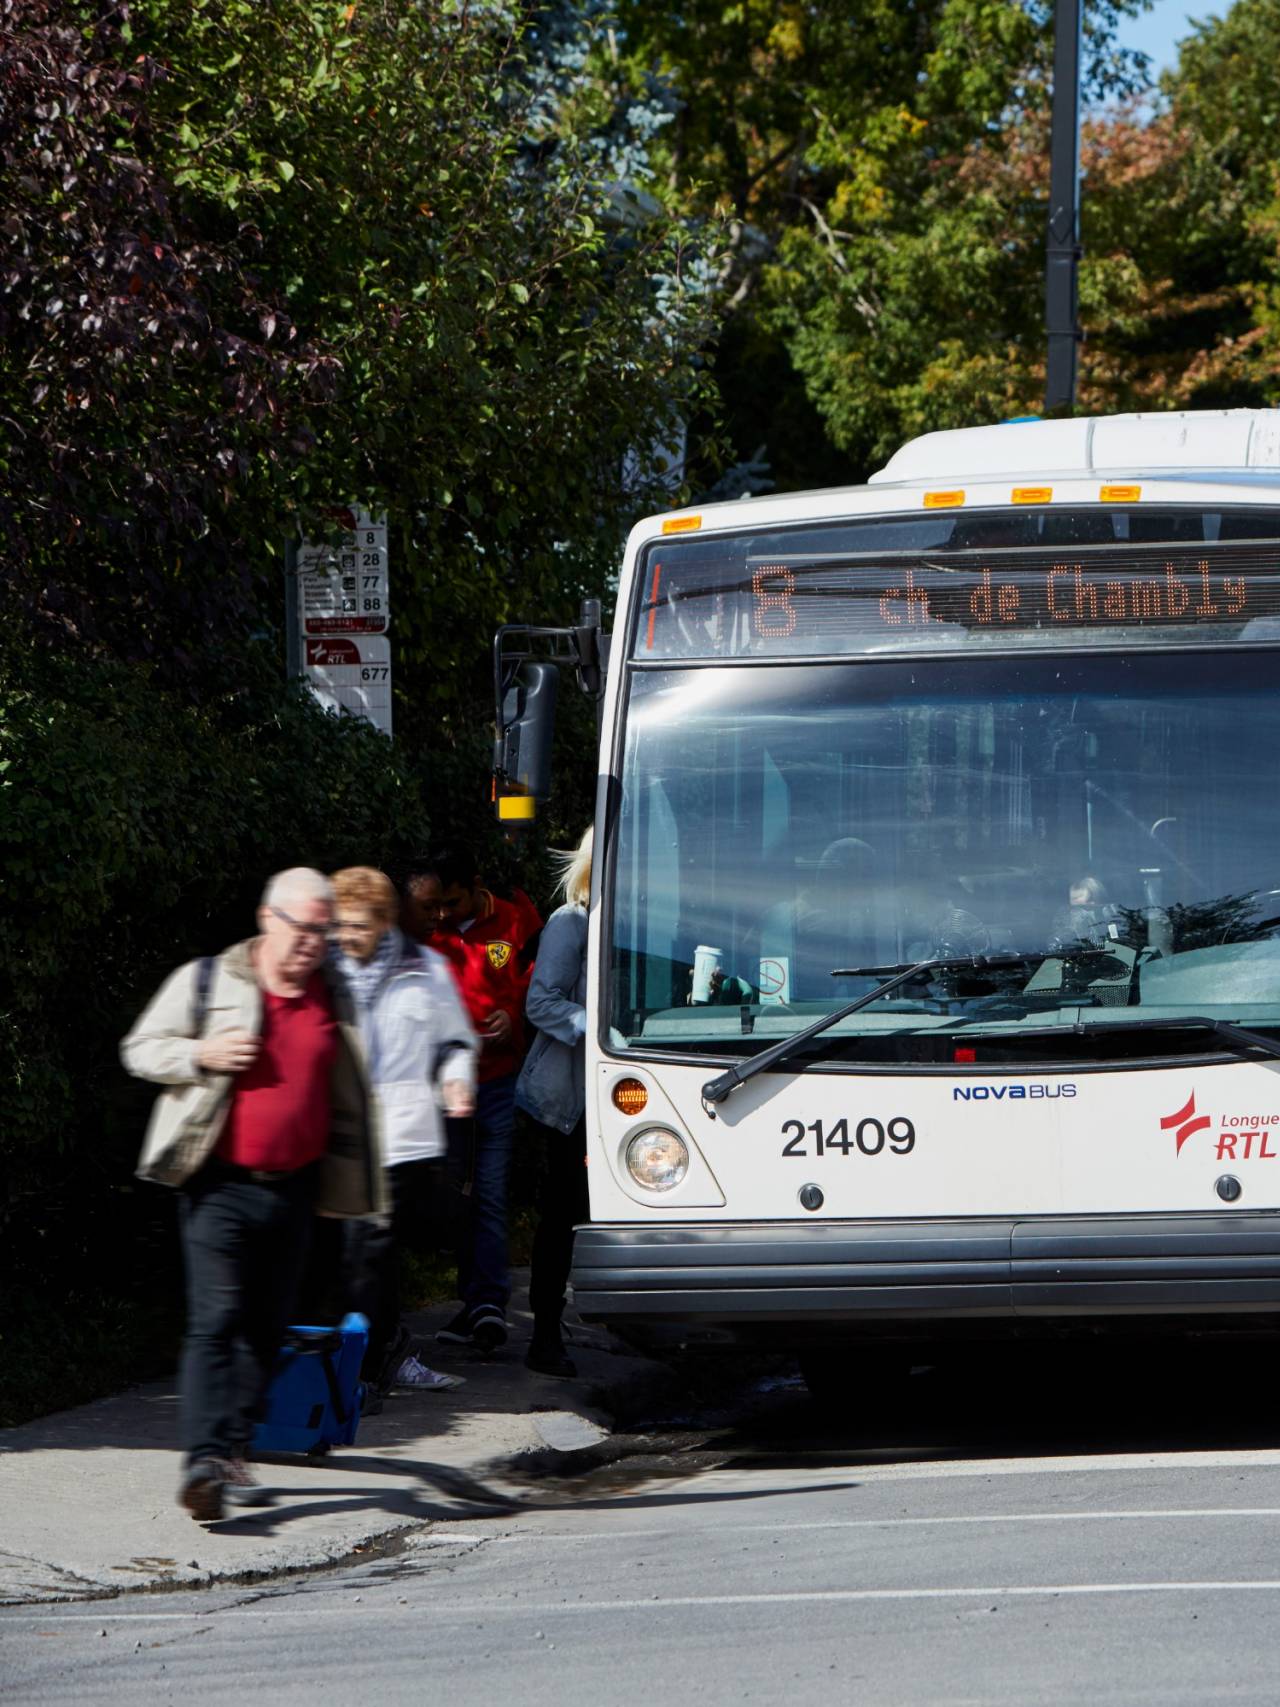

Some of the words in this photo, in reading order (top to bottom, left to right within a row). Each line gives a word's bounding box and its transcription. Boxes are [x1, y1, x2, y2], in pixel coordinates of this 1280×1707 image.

[366, 532, 375, 544] 8
[362, 553, 380, 566] 28
[362, 576, 379, 588] 77
[363, 598, 381, 611] 88
[752, 565, 796, 637] 8
[969, 568, 1020, 622] de
[1047, 560, 1246, 619] Chambly
[327, 654, 345, 664] RTL
[362, 668, 389, 681] 677
[780, 1116, 917, 1158] 21409
[1213, 1131, 1277, 1160] RTL
